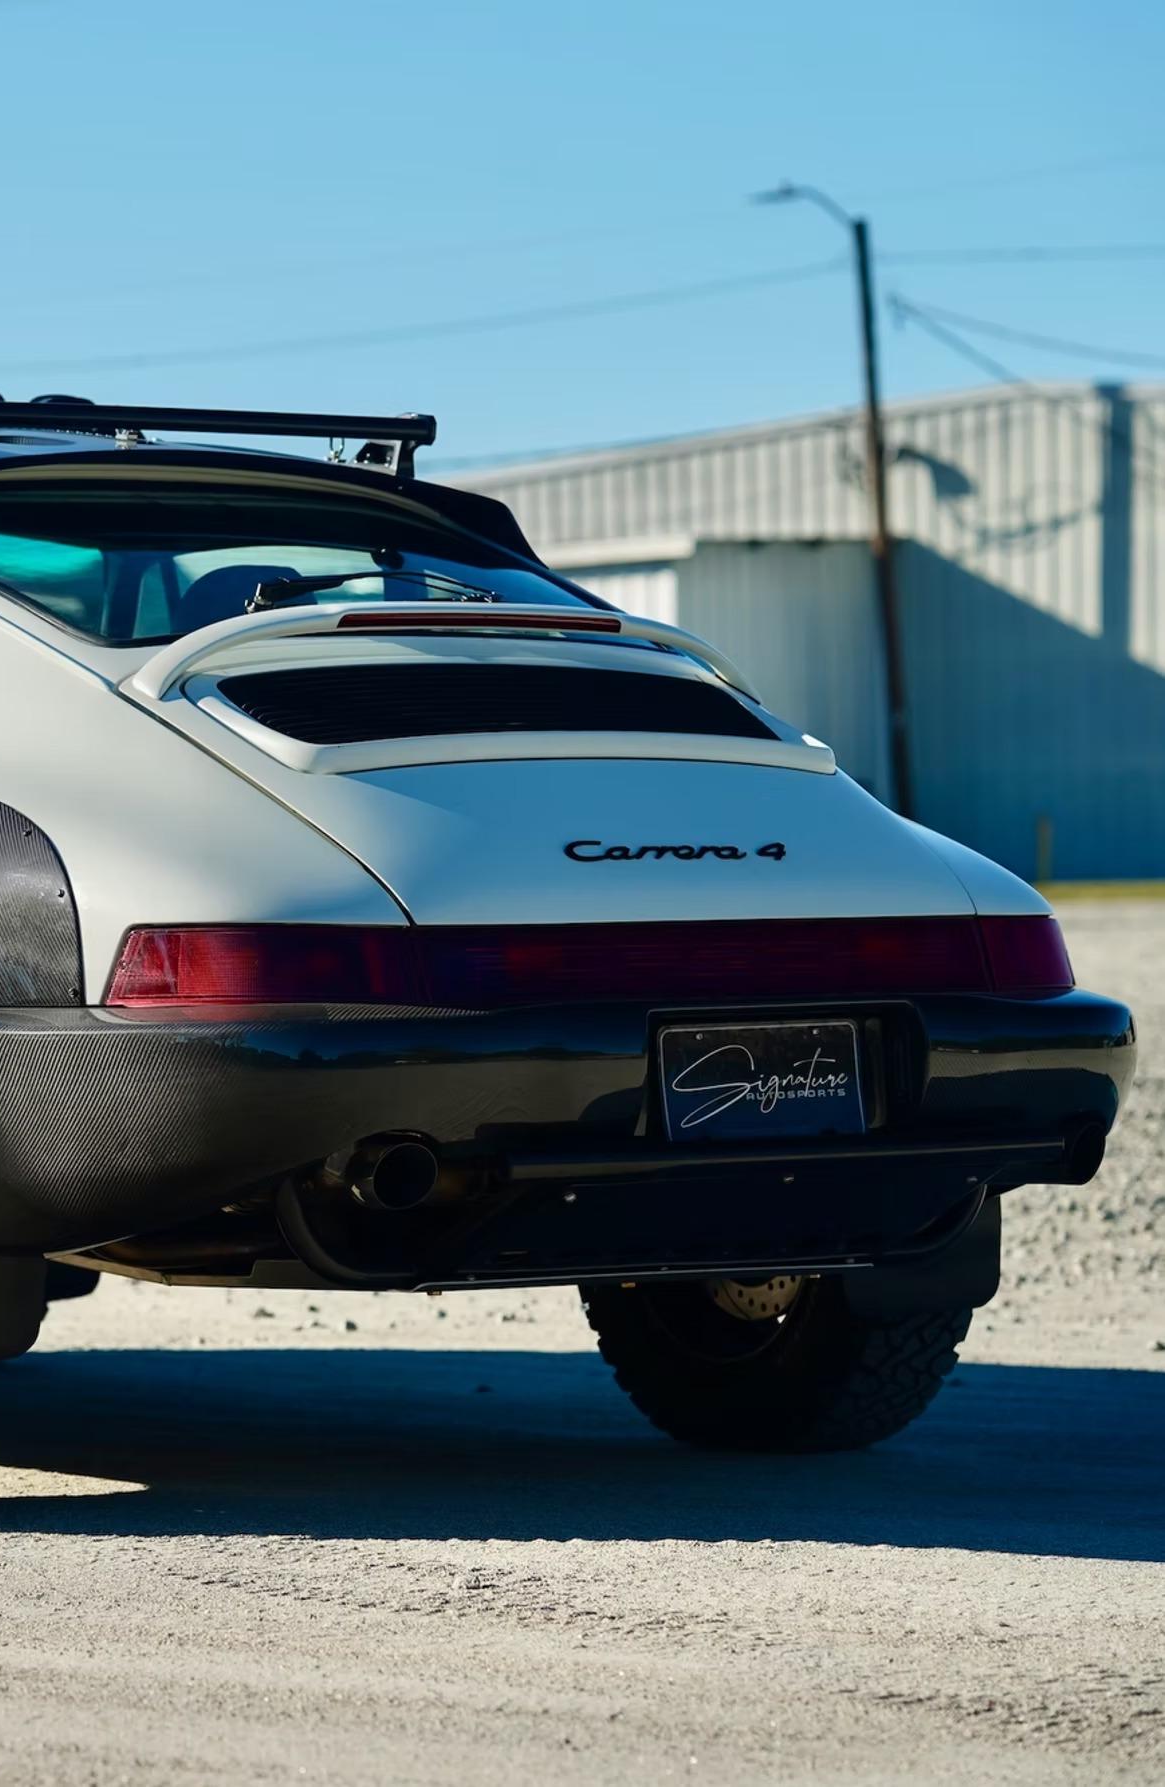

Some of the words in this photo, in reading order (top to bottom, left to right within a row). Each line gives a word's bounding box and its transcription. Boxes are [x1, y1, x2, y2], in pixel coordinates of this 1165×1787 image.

[563, 840, 747, 861] Carrera
[756, 842, 787, 861] 4
[671, 1044, 849, 1128] Signature
[745, 1088, 847, 1101] AUTOSPORTS
